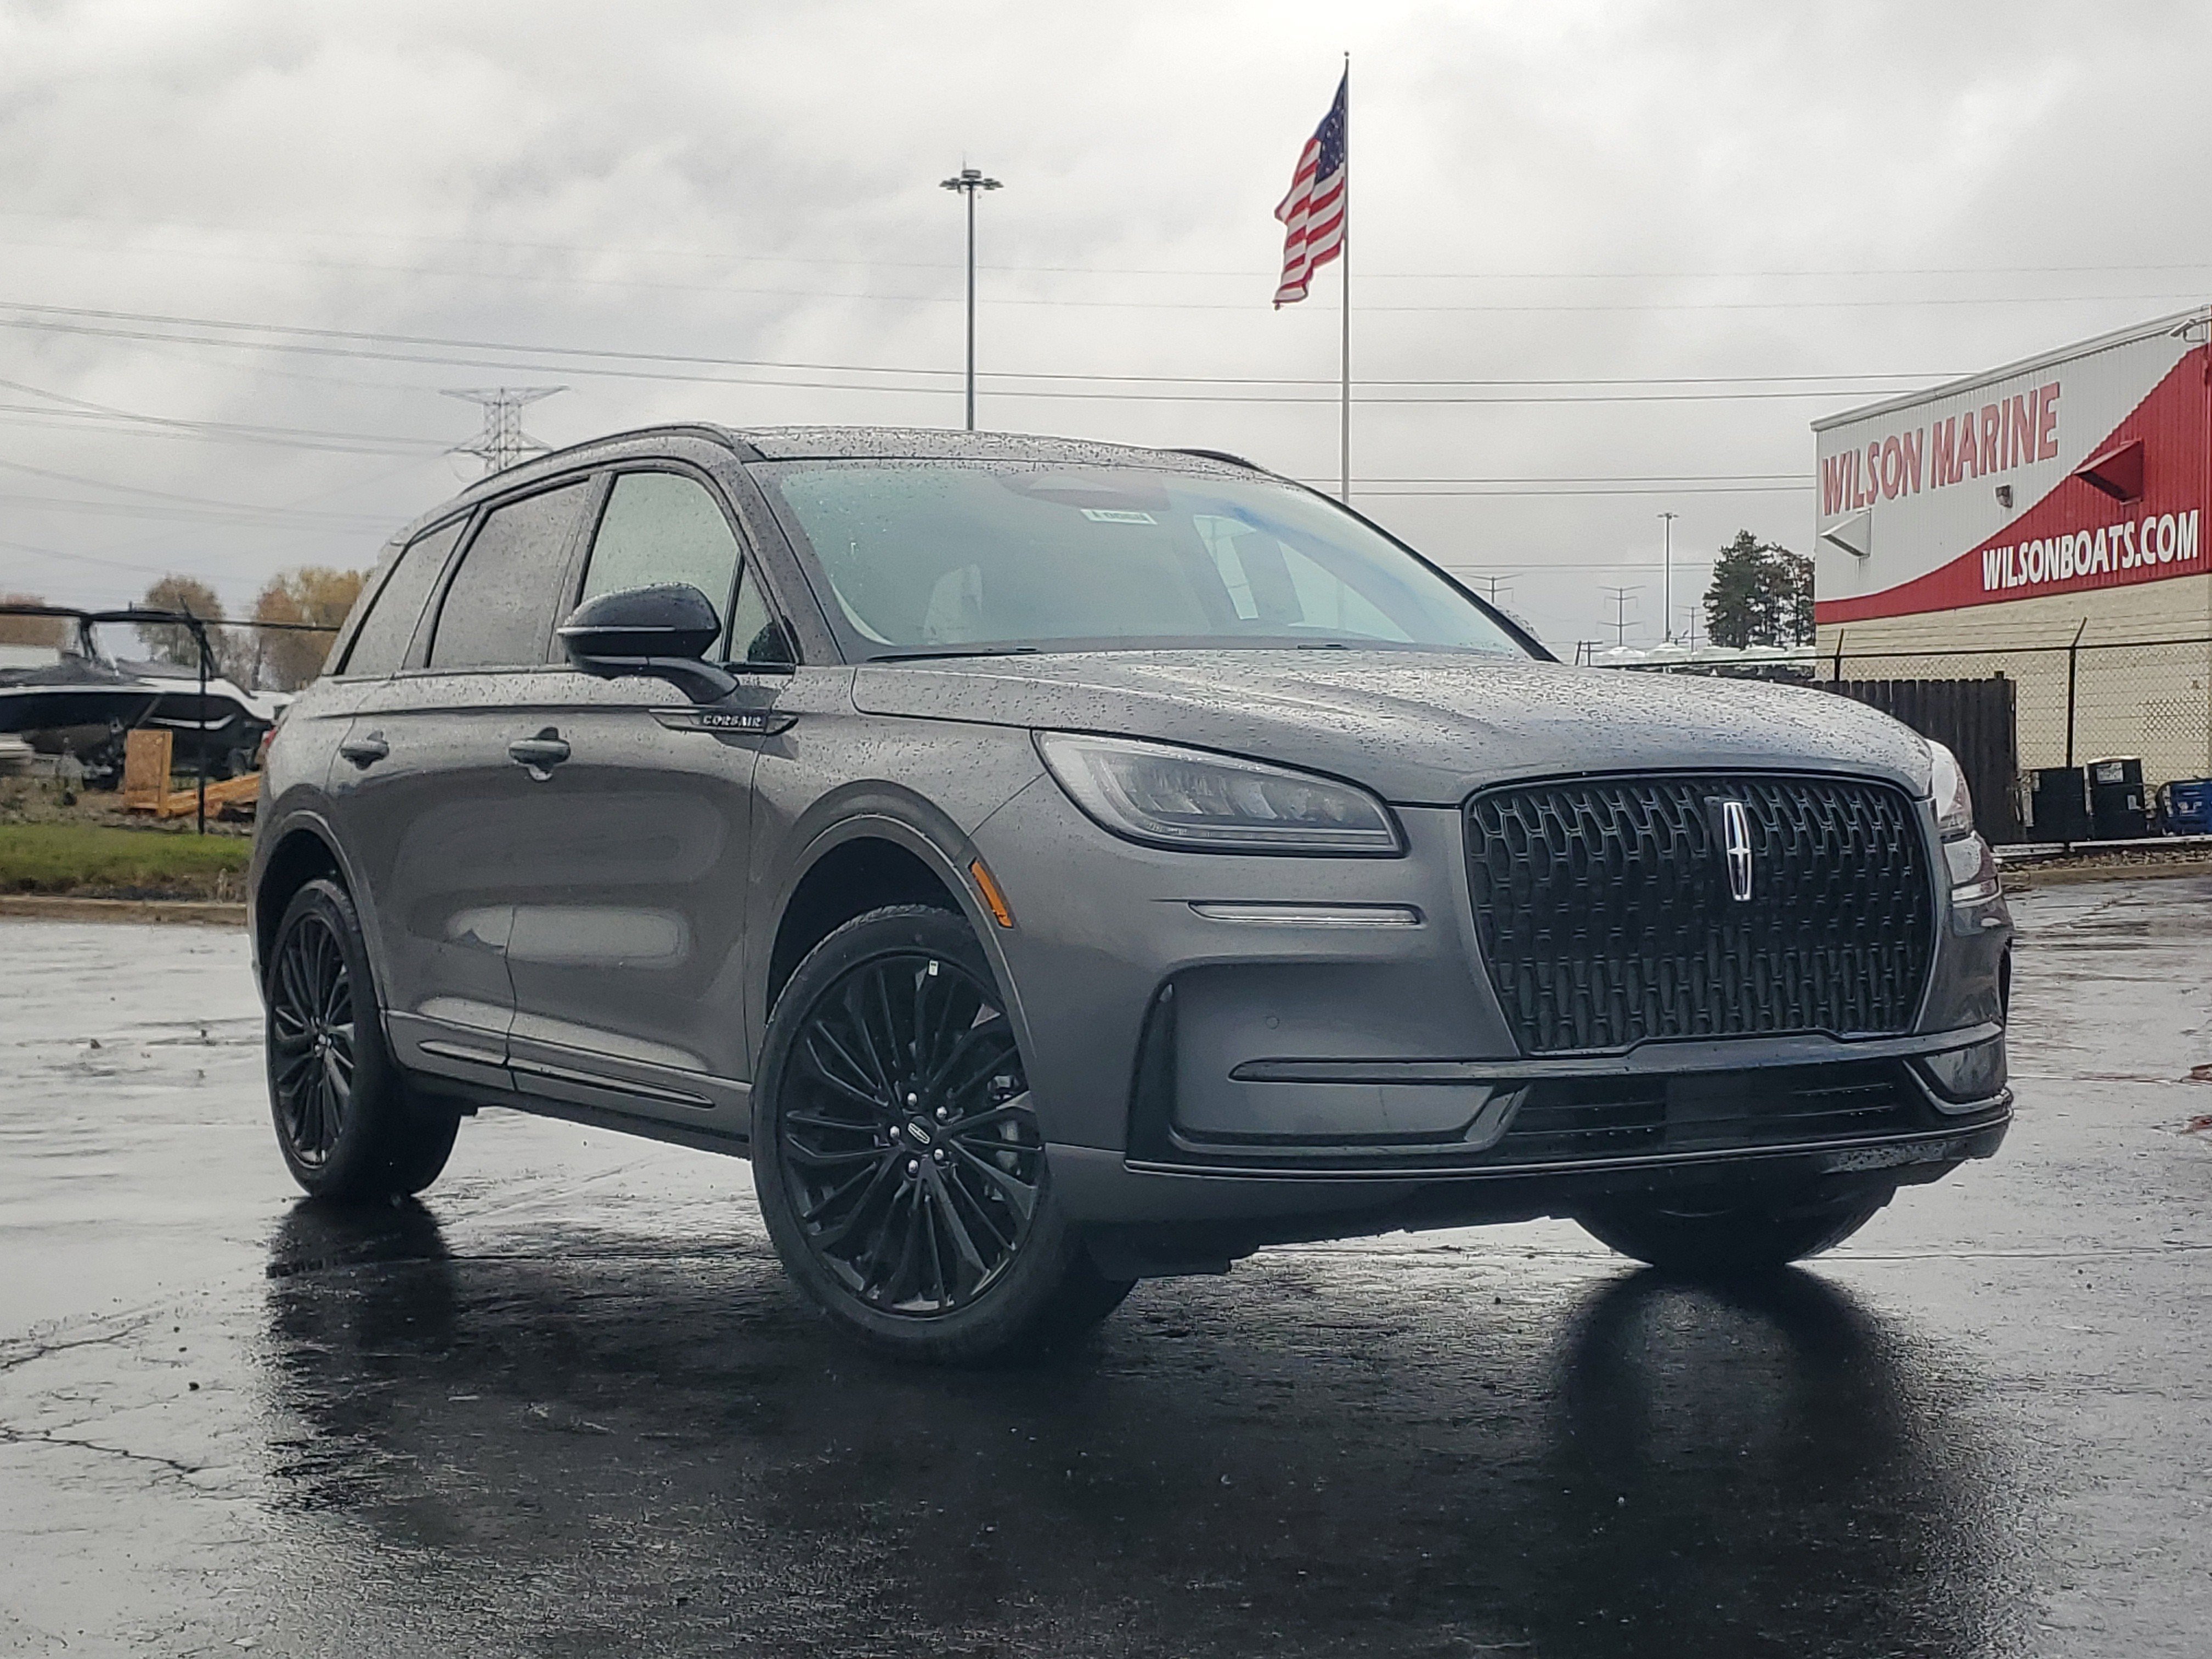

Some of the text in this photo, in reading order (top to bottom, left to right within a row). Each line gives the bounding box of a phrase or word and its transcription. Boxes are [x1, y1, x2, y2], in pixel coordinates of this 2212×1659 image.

[1822, 382, 2059, 516] WILSON MARINE
[1982, 510, 2199, 590] WILSONBOATS.COM
[703, 714, 763, 727] CORSAIR
